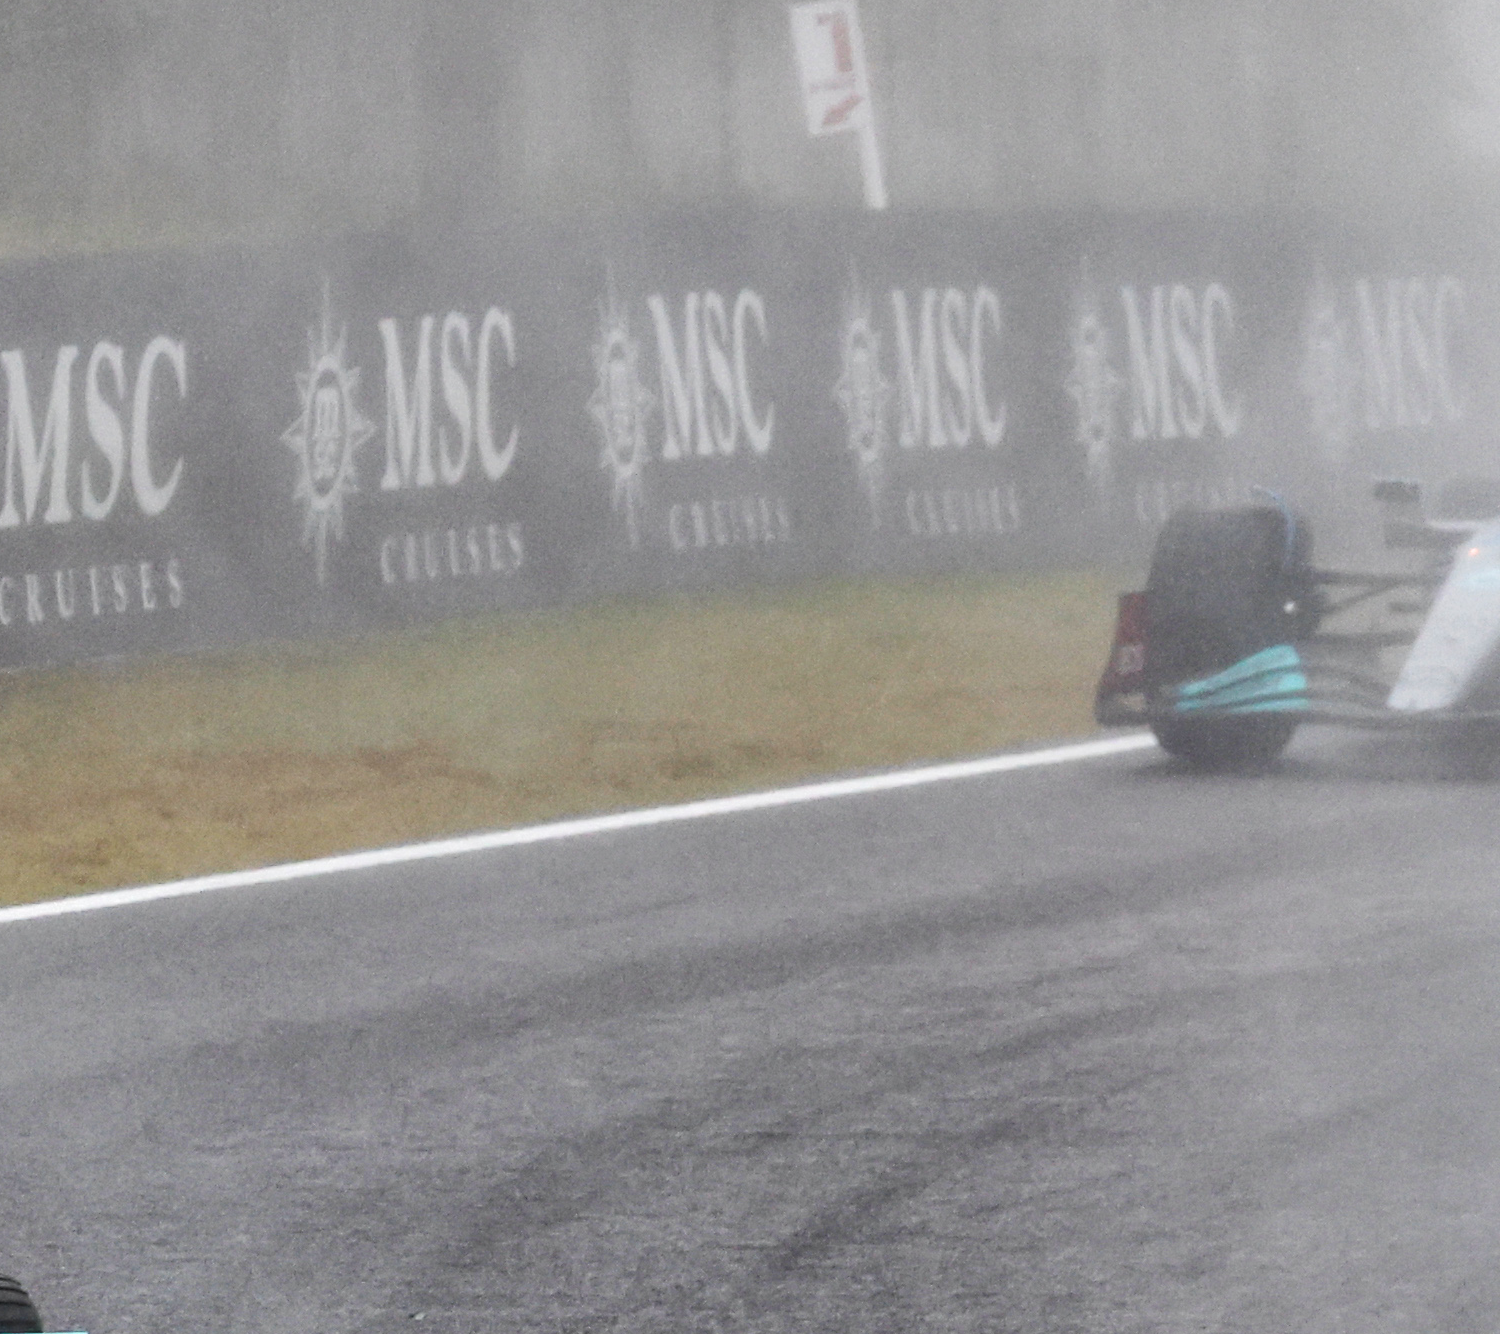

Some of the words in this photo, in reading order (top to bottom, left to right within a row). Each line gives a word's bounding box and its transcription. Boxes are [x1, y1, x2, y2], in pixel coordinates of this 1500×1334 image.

[0, 334, 187, 529] MSC
[378, 307, 521, 491] MSC
[647, 288, 776, 460] MSC
[892, 283, 1007, 449] MSC
[1118, 281, 1242, 440] MSC
